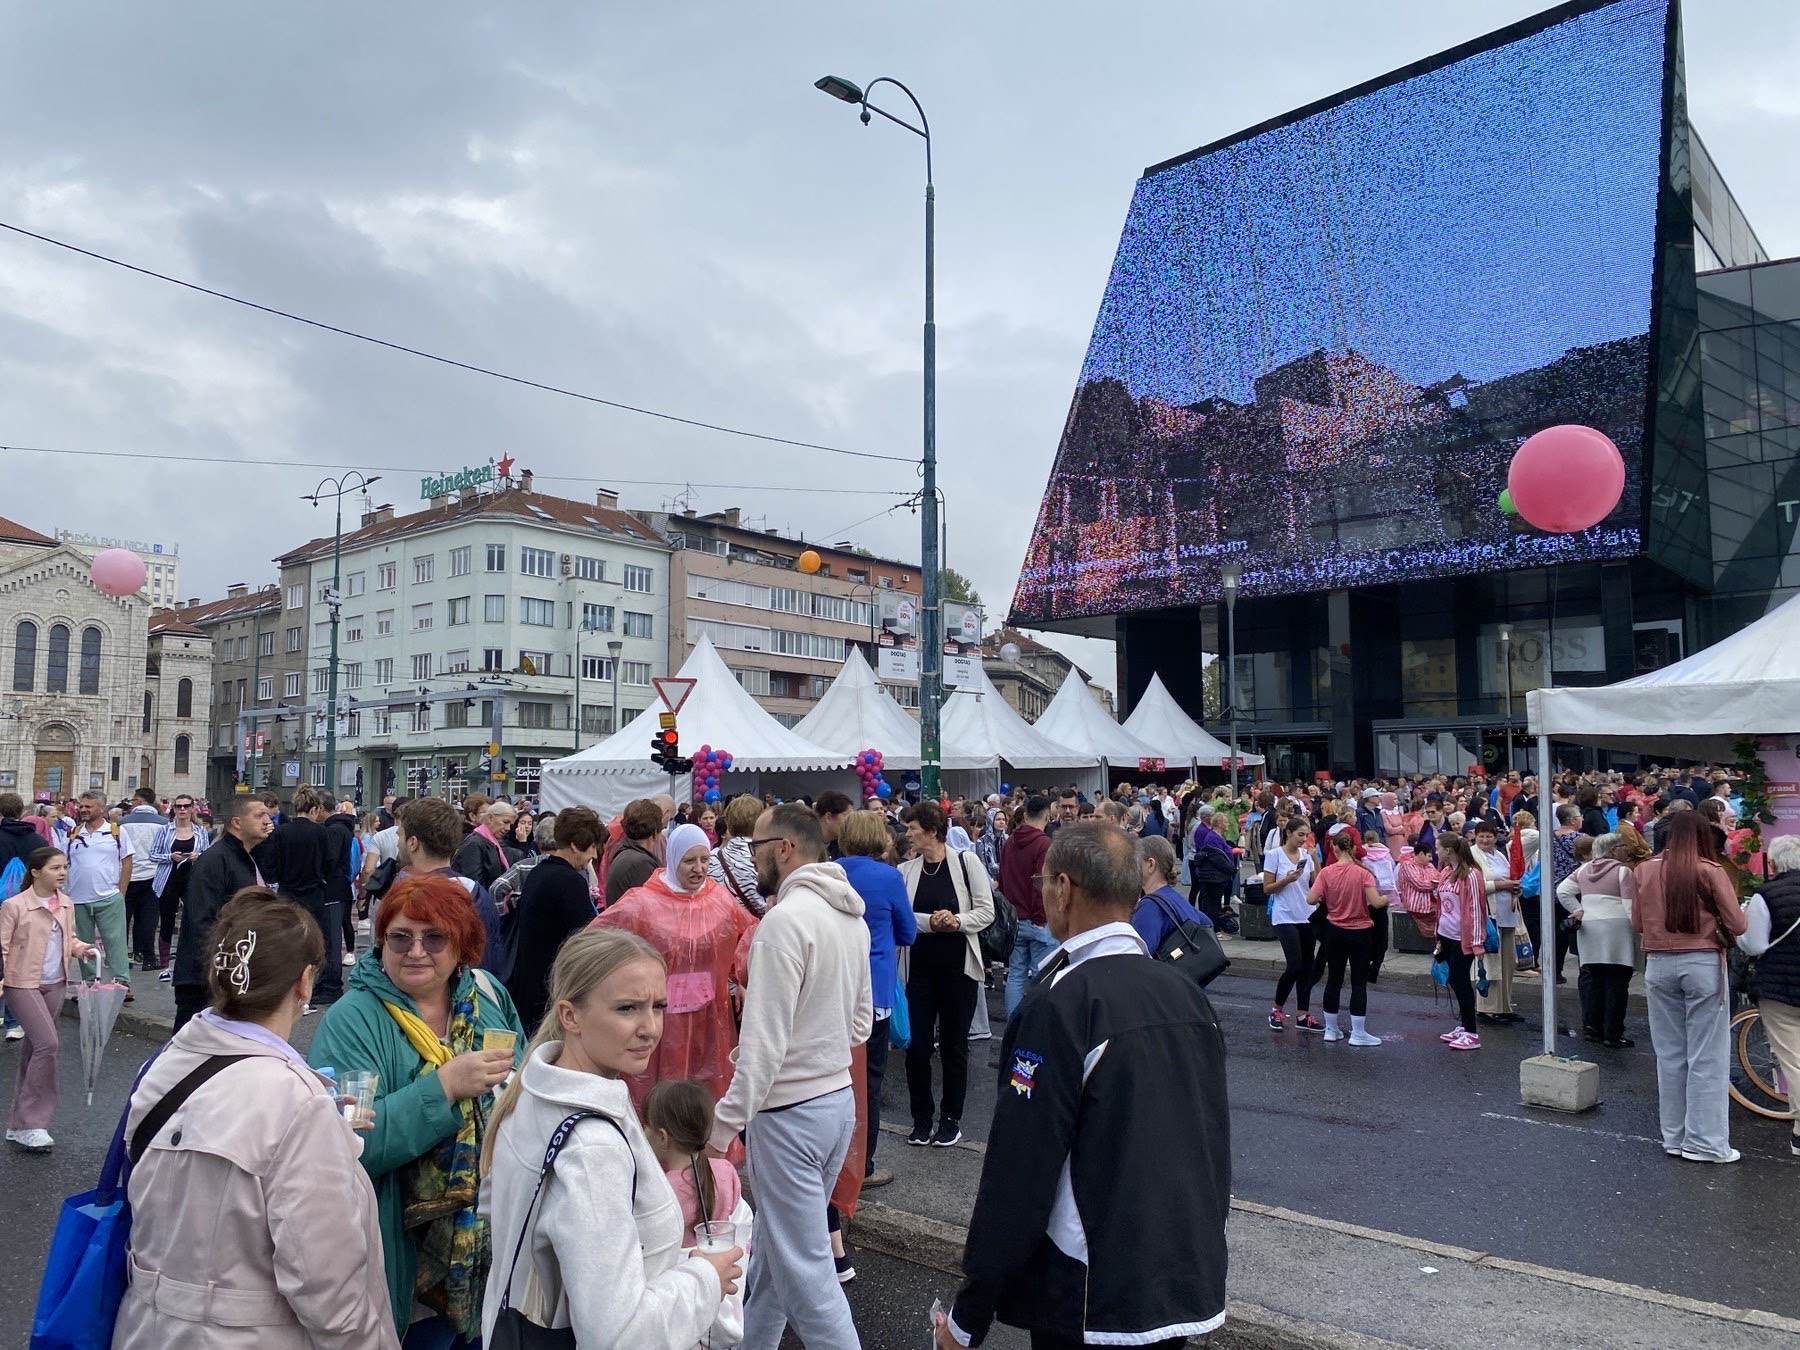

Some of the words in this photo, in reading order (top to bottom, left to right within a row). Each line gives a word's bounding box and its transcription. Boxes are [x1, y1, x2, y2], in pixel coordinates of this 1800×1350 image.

[421, 465, 492, 499] Heineken
[1515, 534, 1576, 553] Free
[1767, 785, 1796, 794] grand
